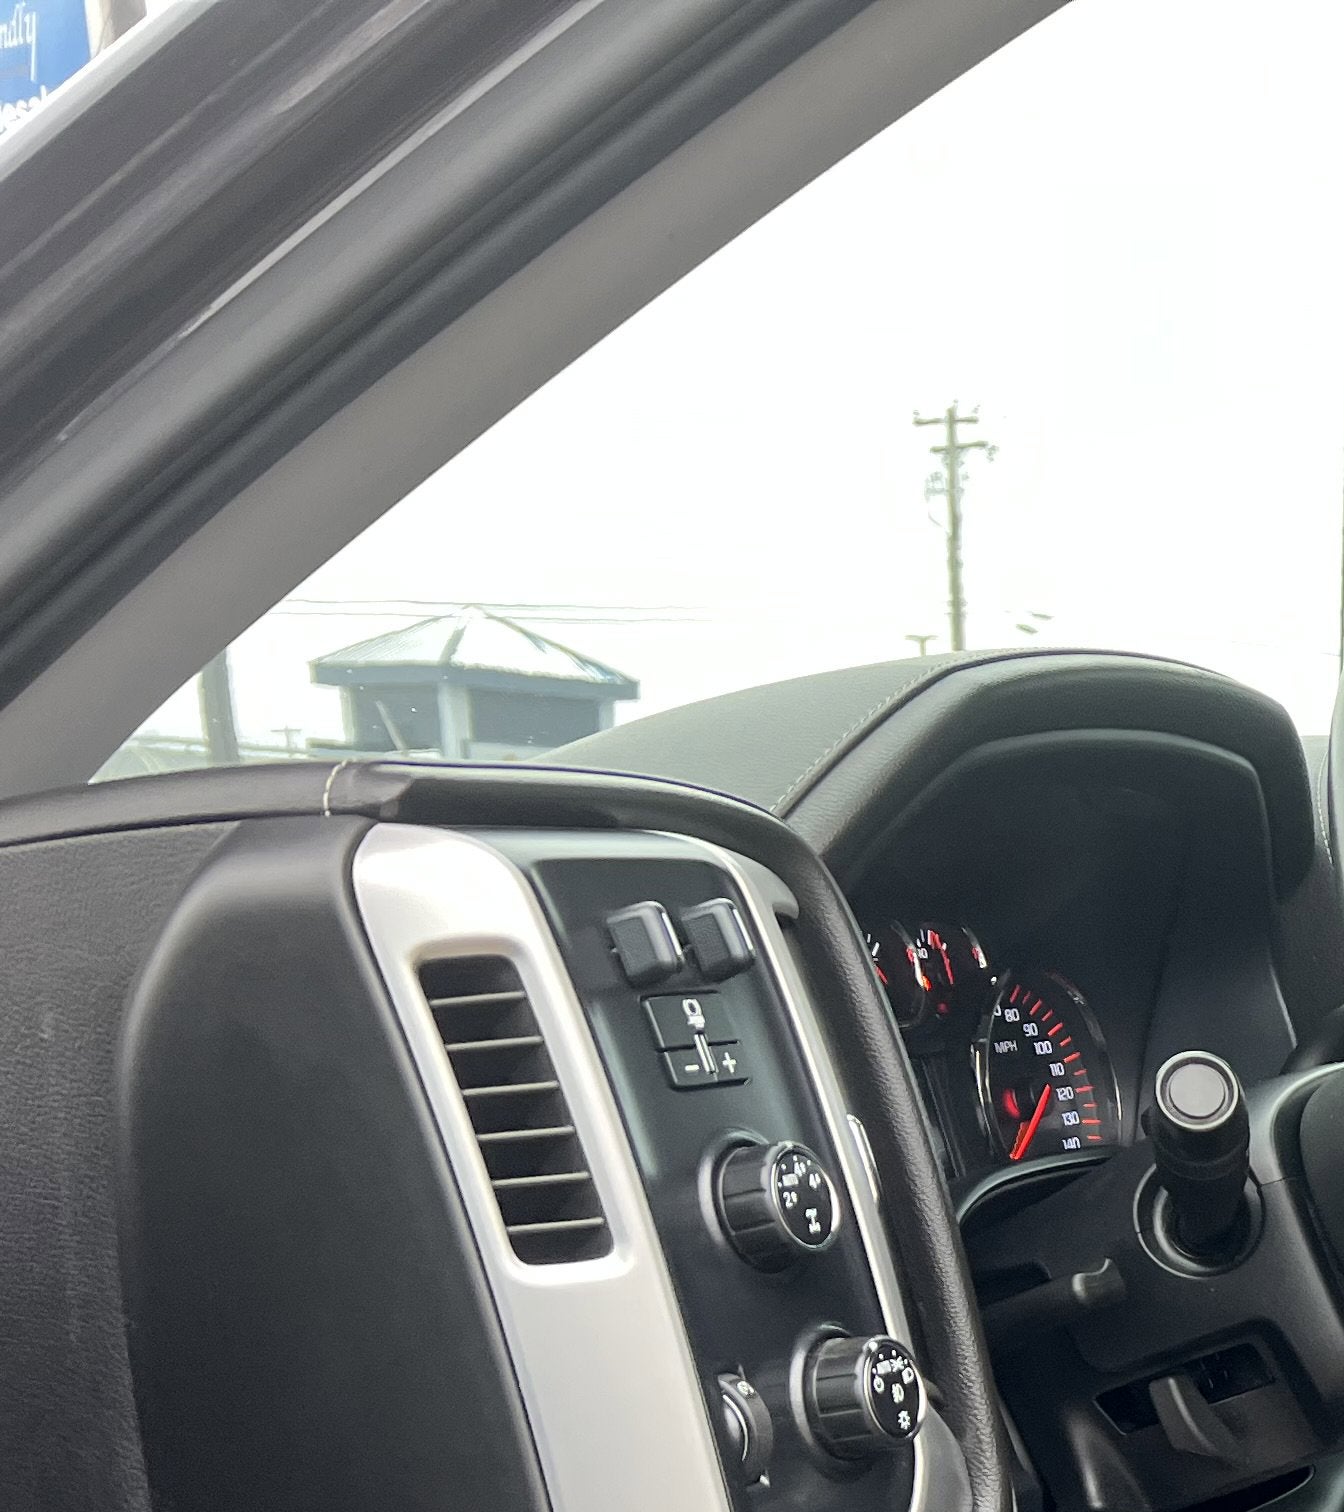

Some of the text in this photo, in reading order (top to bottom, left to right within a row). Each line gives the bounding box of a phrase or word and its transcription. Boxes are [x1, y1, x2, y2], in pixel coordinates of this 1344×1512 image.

[1004, 1008, 1020, 1022] 80
[1023, 1022, 1039, 1037] 90
[994, 1040, 1018, 1053] MPH
[1033, 1040, 1053, 1055] 100
[1049, 1062, 1065, 1077] 110
[1056, 1086, 1074, 1101] 120
[1062, 1111, 1080, 1126] 130
